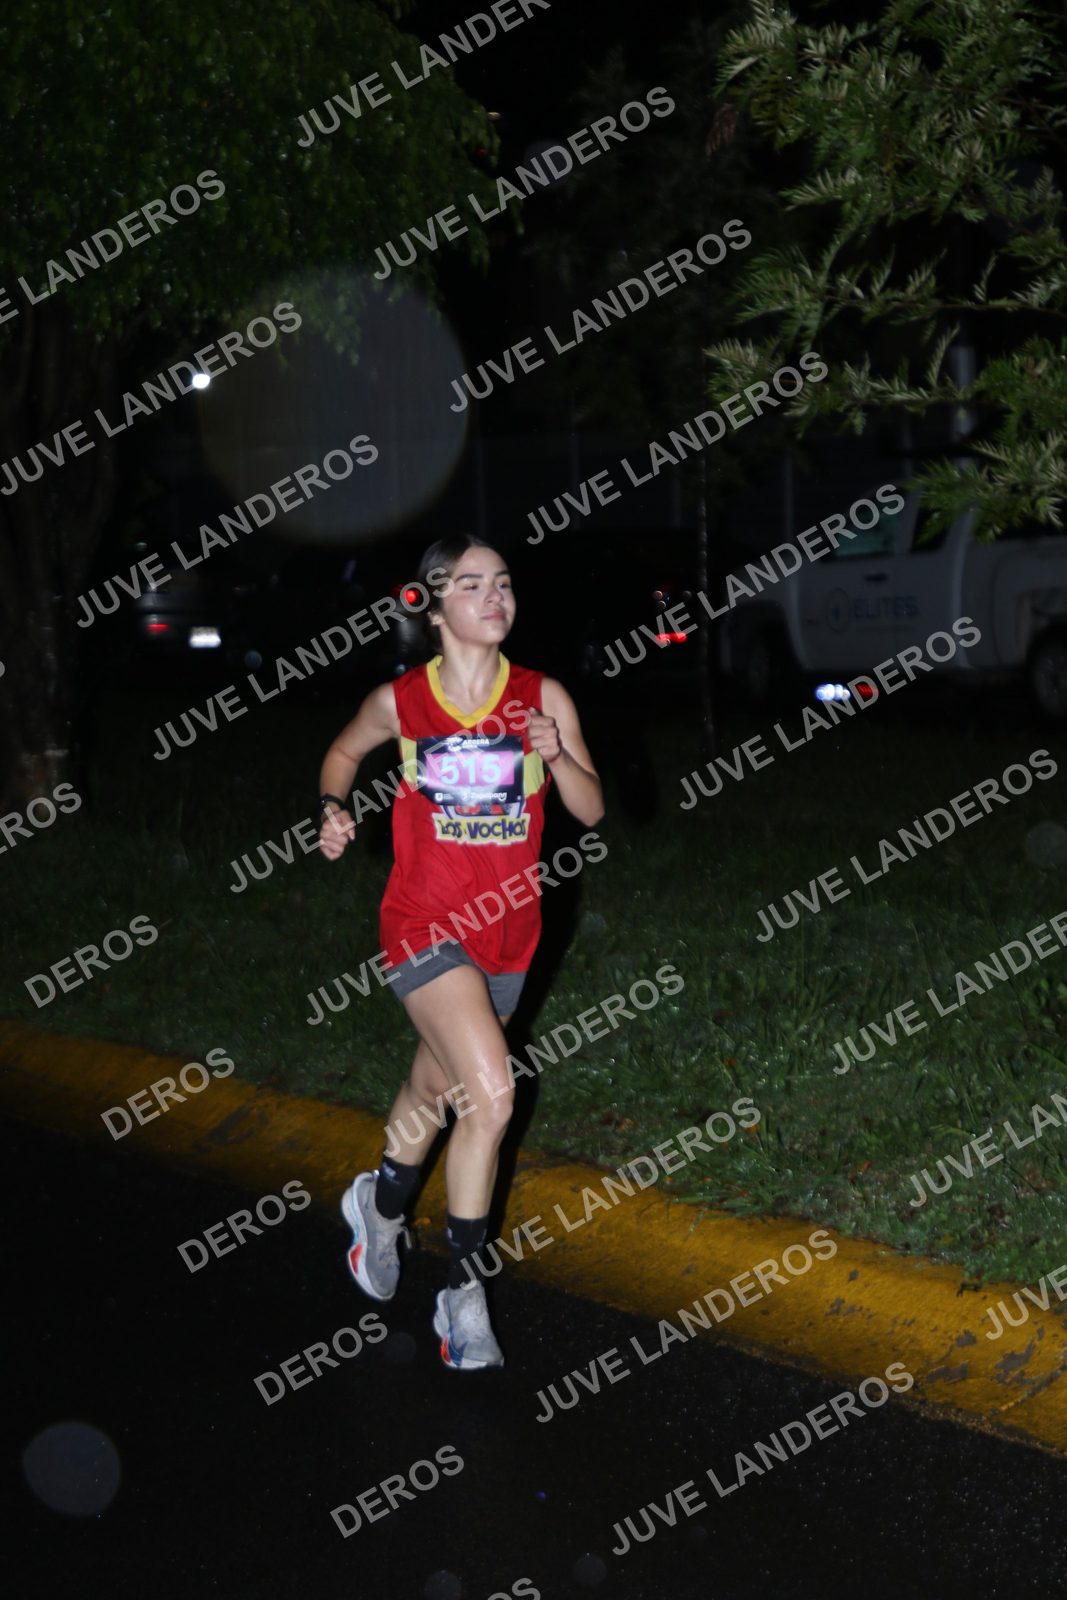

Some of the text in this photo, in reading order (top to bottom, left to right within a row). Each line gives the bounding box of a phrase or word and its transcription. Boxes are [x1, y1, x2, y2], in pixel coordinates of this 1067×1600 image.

[440, 754, 501, 785] 515
[438, 818, 526, 839] LOS VOCHOS
